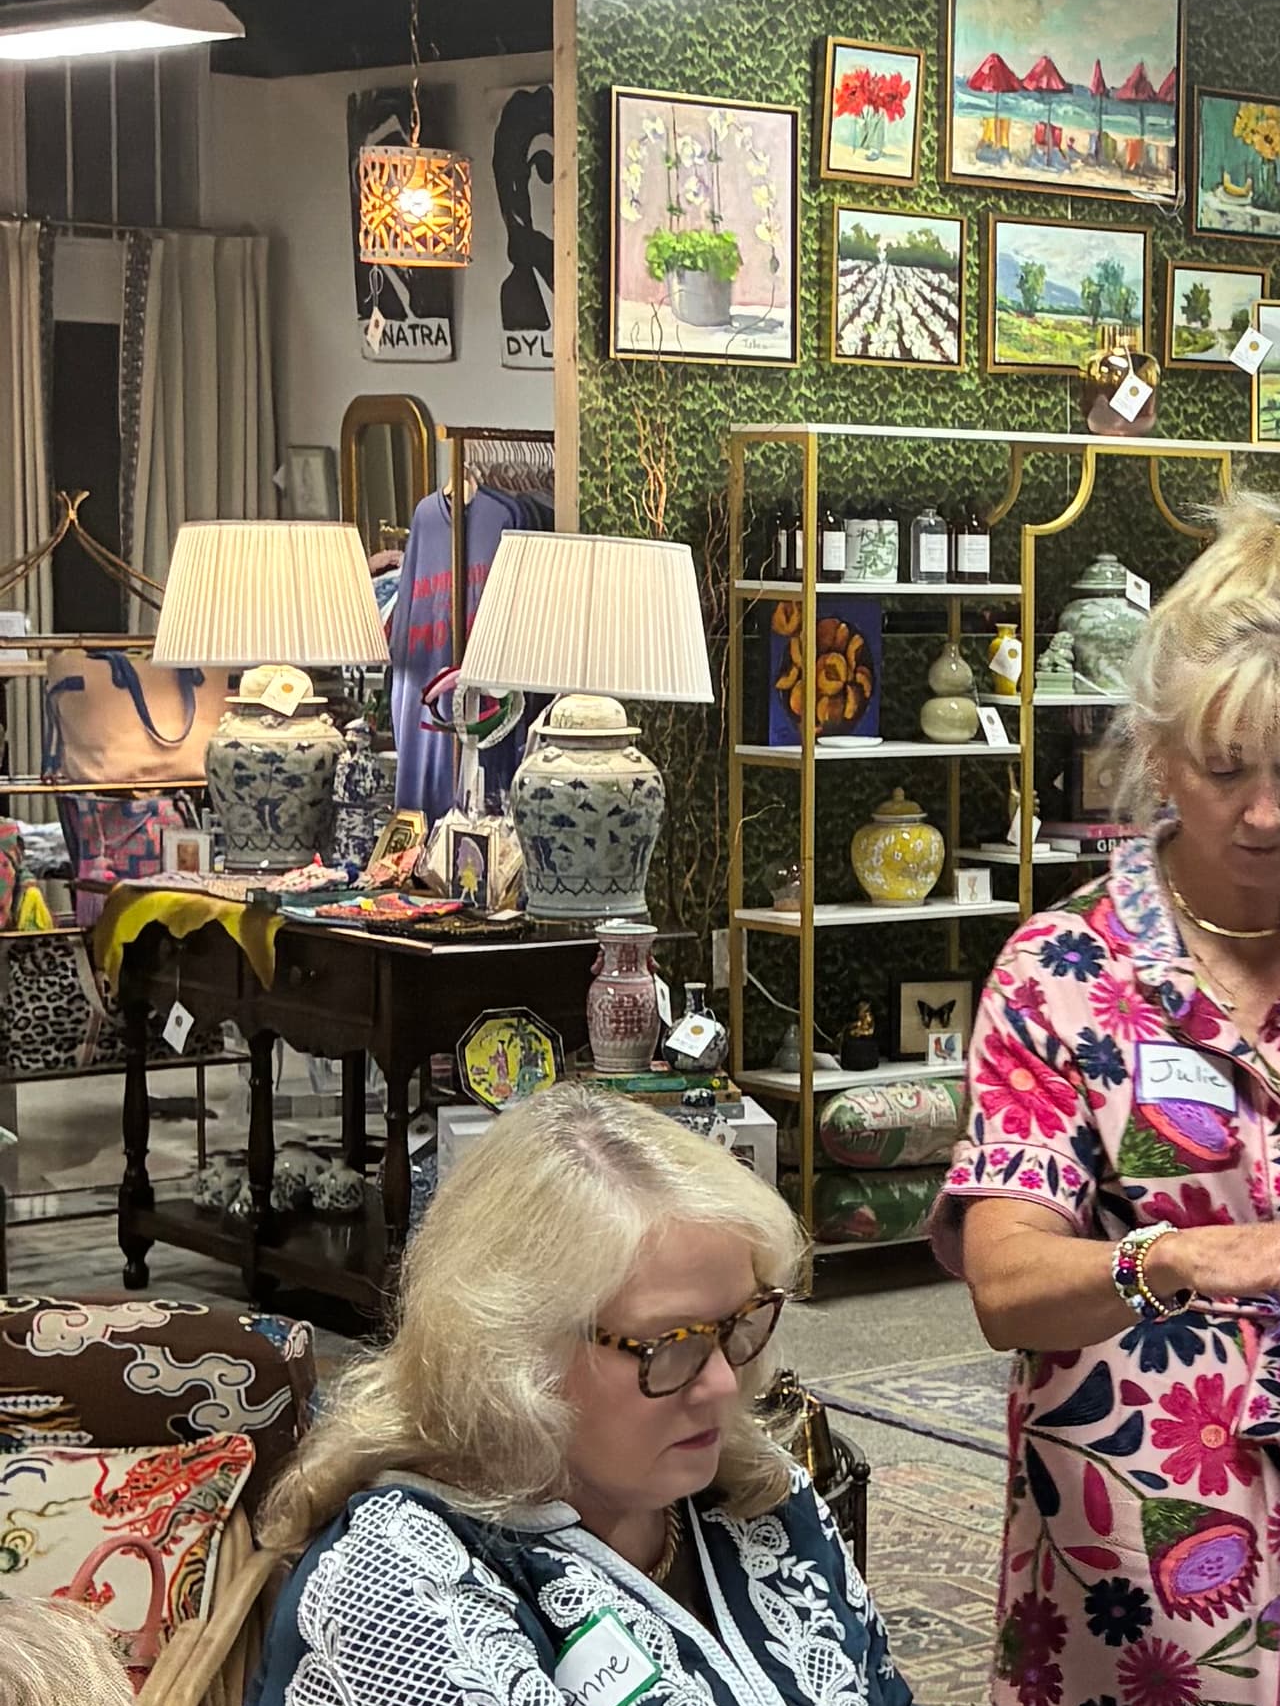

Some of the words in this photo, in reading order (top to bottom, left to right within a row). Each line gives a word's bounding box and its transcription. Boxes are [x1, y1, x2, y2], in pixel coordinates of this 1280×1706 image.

[364, 324, 448, 348] NATRA
[507, 336, 553, 357] DYL
[1150, 1058, 1227, 1087] Julie
